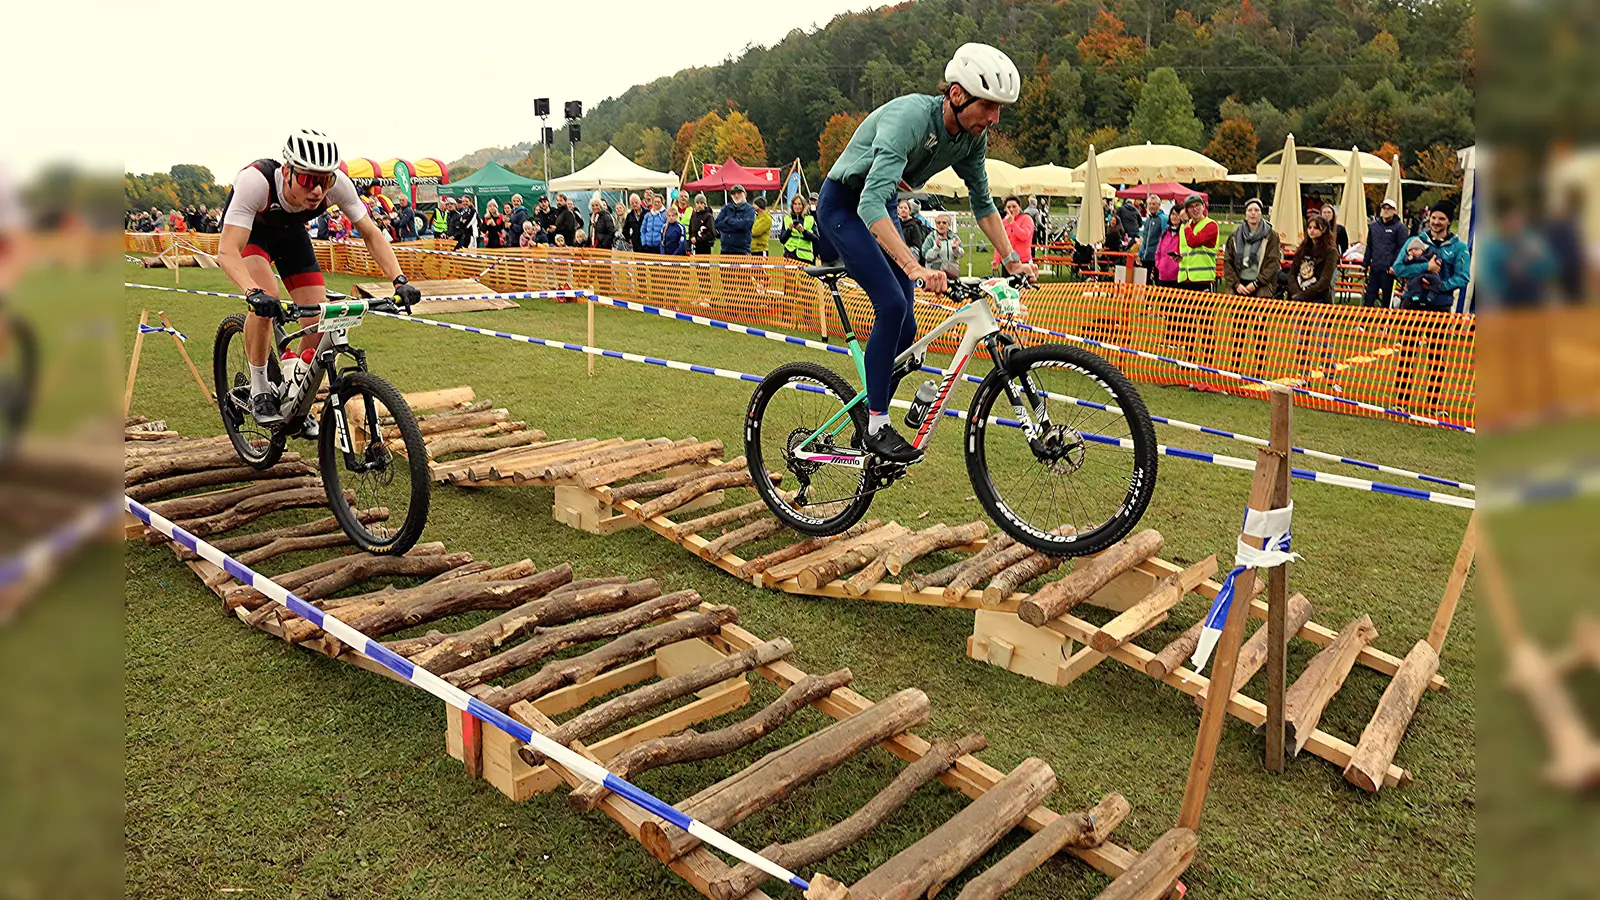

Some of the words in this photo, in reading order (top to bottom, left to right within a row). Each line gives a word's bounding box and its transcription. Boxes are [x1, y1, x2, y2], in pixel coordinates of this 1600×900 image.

[354, 178, 373, 186] TINY
[339, 305, 350, 317] 3
[767, 489, 825, 525] REYNOLDS
[1125, 467, 1144, 517] MAXXIS
[995, 501, 1078, 543] REYNOLDS
